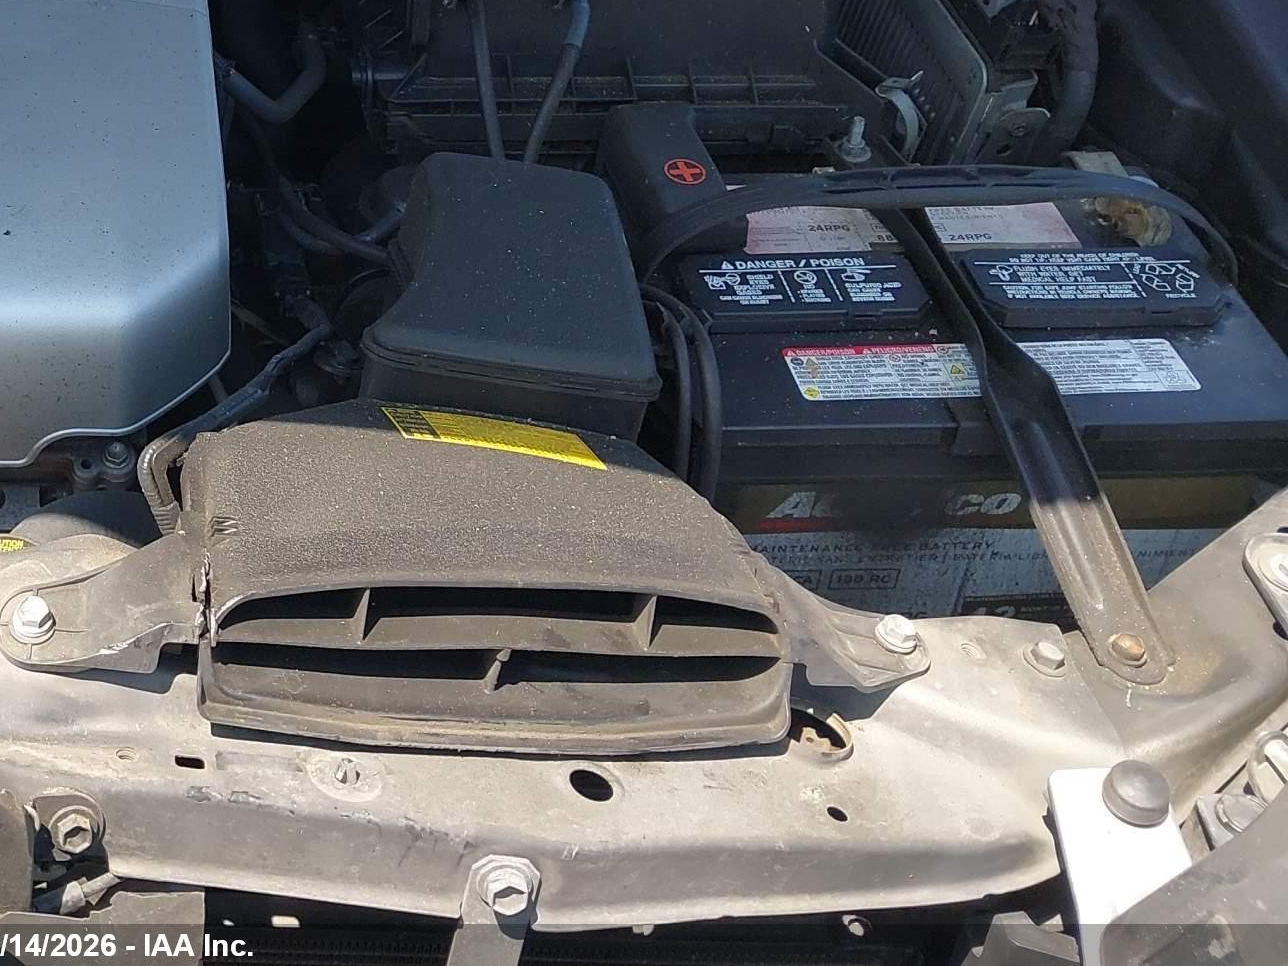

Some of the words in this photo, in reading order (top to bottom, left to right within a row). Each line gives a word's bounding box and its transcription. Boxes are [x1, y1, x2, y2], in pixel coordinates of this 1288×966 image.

[949, 233, 993, 242] 24RPG
[734, 259, 796, 269] DANGER
[798, 259, 807, 268] /
[810, 257, 865, 267] POISON
